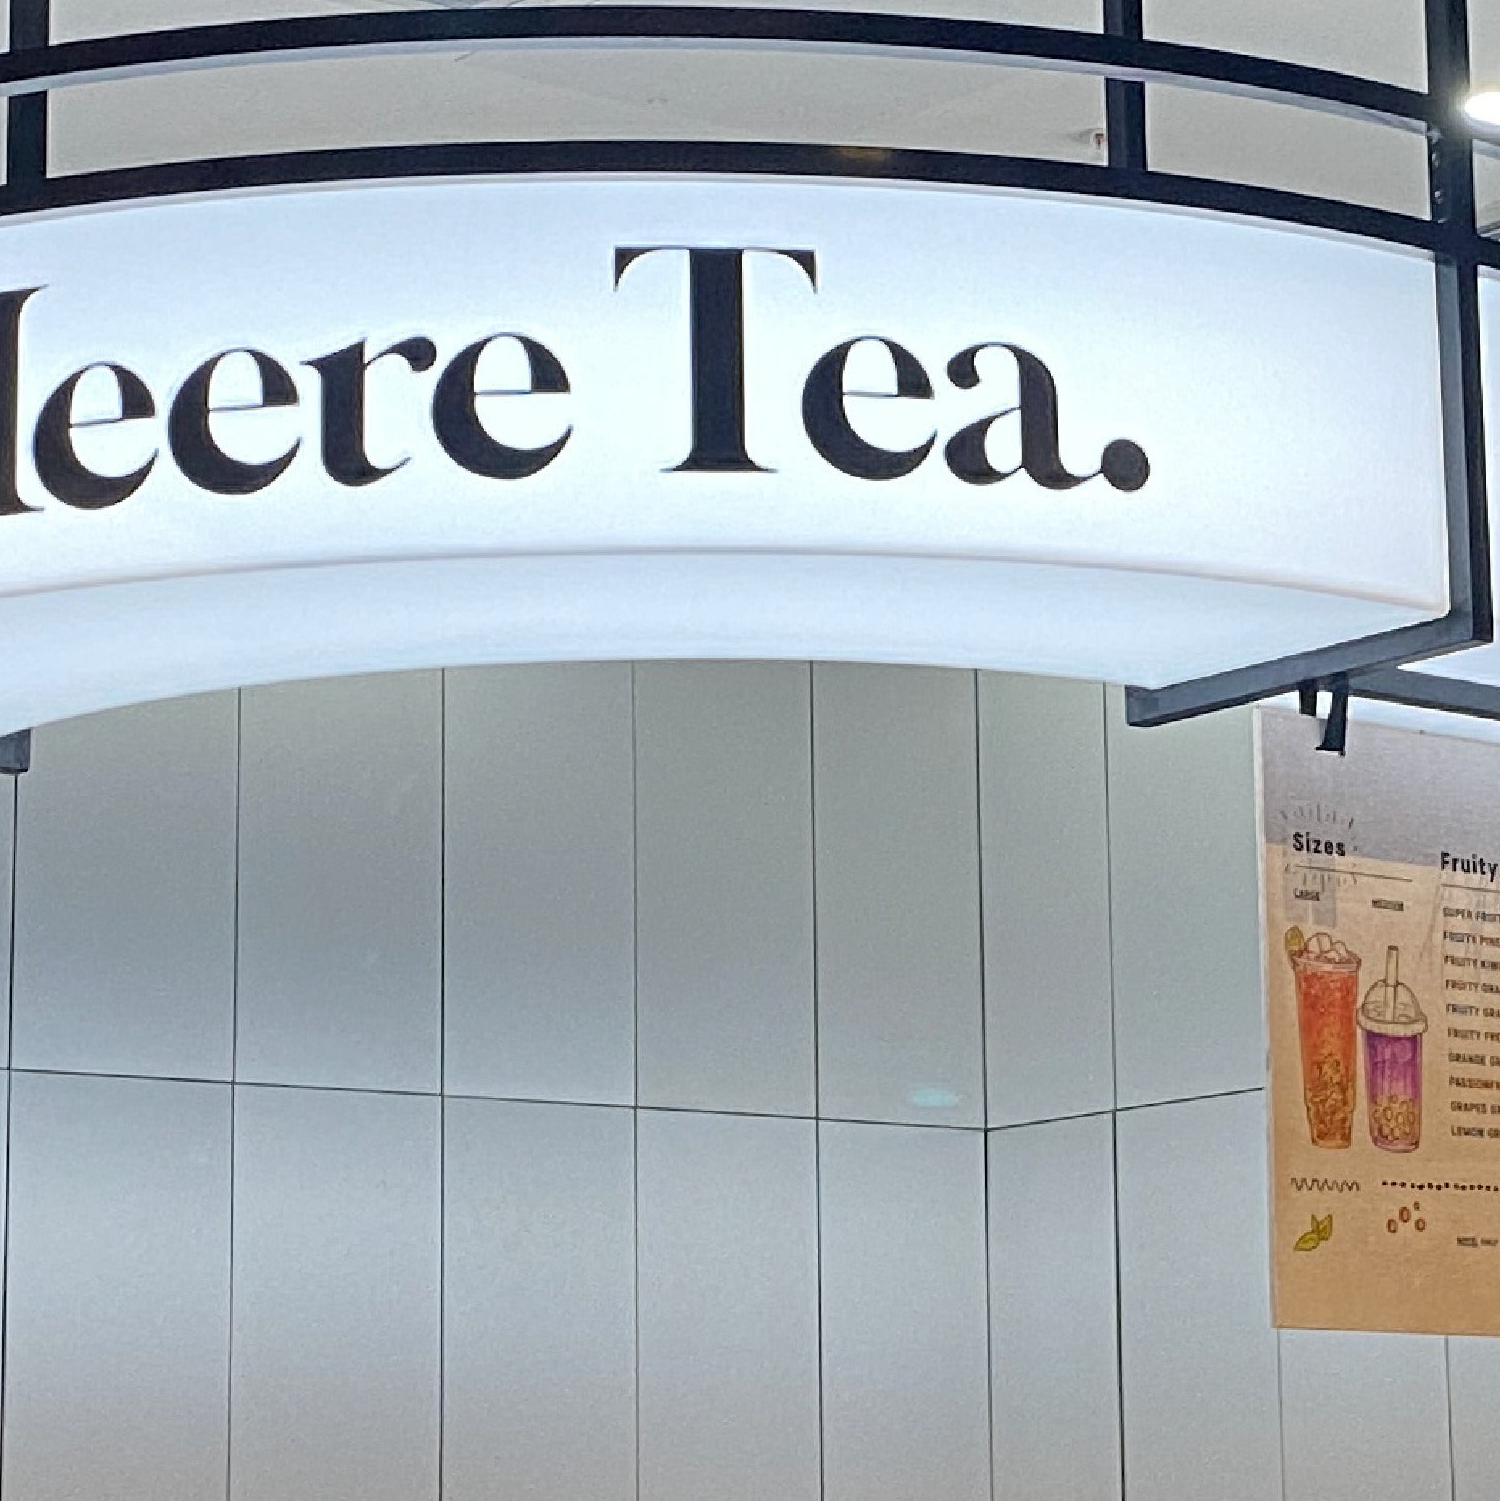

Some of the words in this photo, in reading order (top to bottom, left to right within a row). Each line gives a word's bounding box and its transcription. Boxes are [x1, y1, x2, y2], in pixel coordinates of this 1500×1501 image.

[615, 246, 1151, 491] Tea.
[1293, 831, 1346, 857] Sizes
[1441, 851, 1498, 882] Fruity
